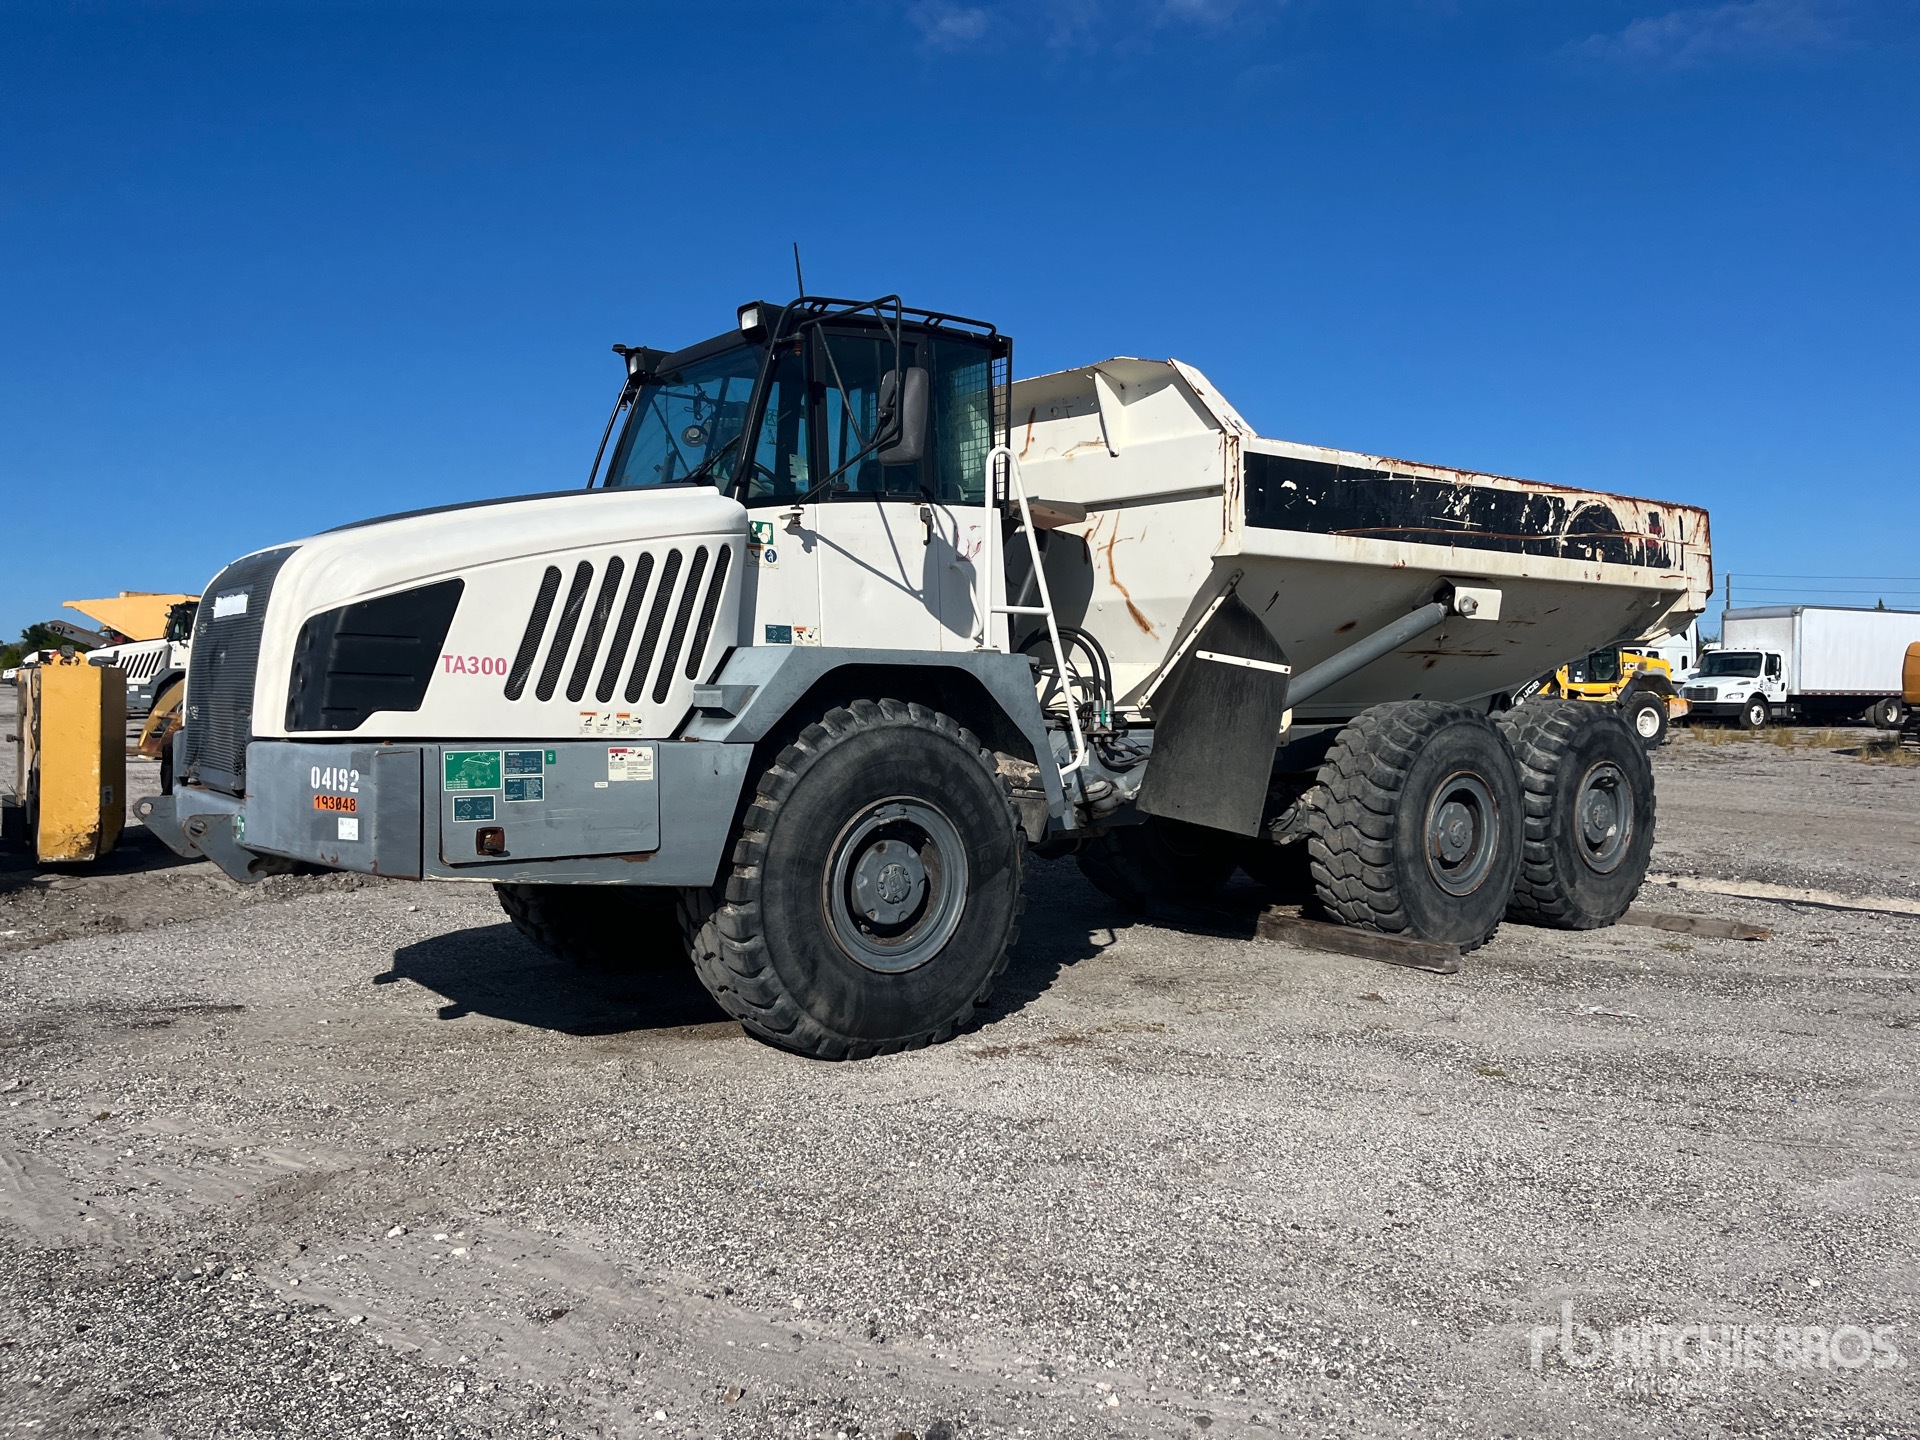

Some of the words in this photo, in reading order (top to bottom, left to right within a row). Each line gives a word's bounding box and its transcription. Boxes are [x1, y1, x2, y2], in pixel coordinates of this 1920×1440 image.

[442, 655, 507, 675] TA300
[1623, 661, 1639, 670] JC
[1522, 680, 1540, 699] JCB
[310, 766, 360, 793] 04192
[315, 795, 356, 812] 193048
